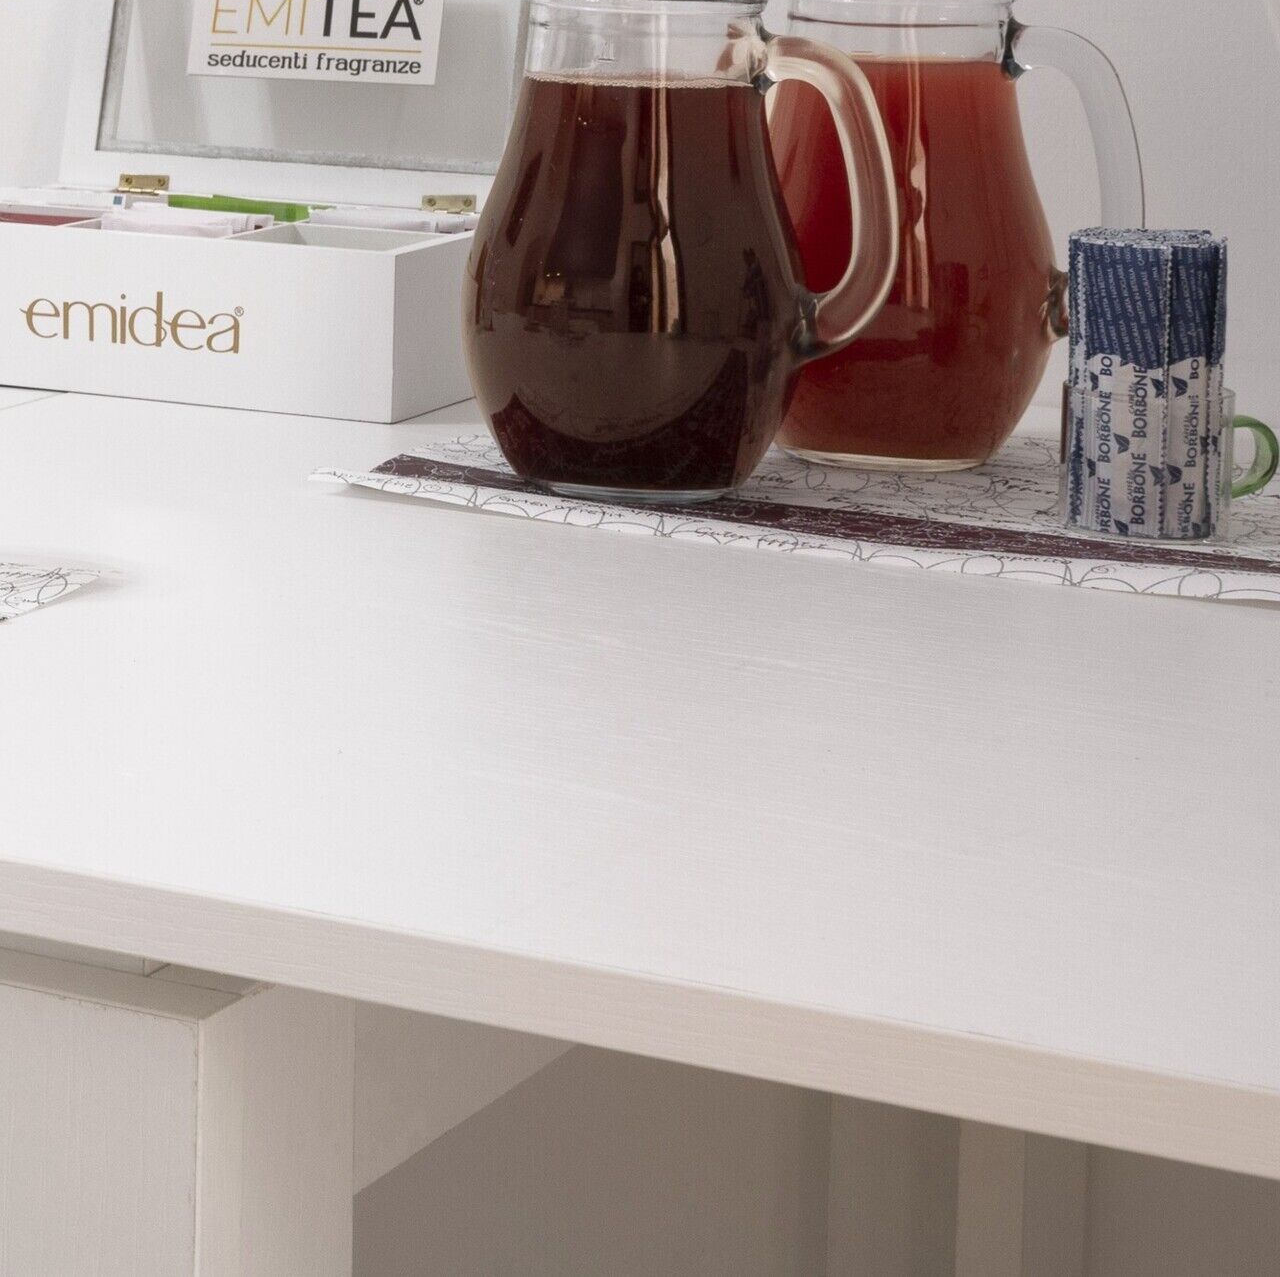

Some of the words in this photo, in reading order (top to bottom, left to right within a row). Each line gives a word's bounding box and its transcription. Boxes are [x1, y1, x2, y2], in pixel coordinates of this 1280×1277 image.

[207, 50, 308, 71] seducenti
[316, 53, 422, 76] fragranze
[1096, 391, 1111, 463] BORBONE
[1131, 366, 1147, 438] BORBONE
[1097, 477, 1111, 533] RBONE
[1130, 452, 1147, 525] BORBONE
